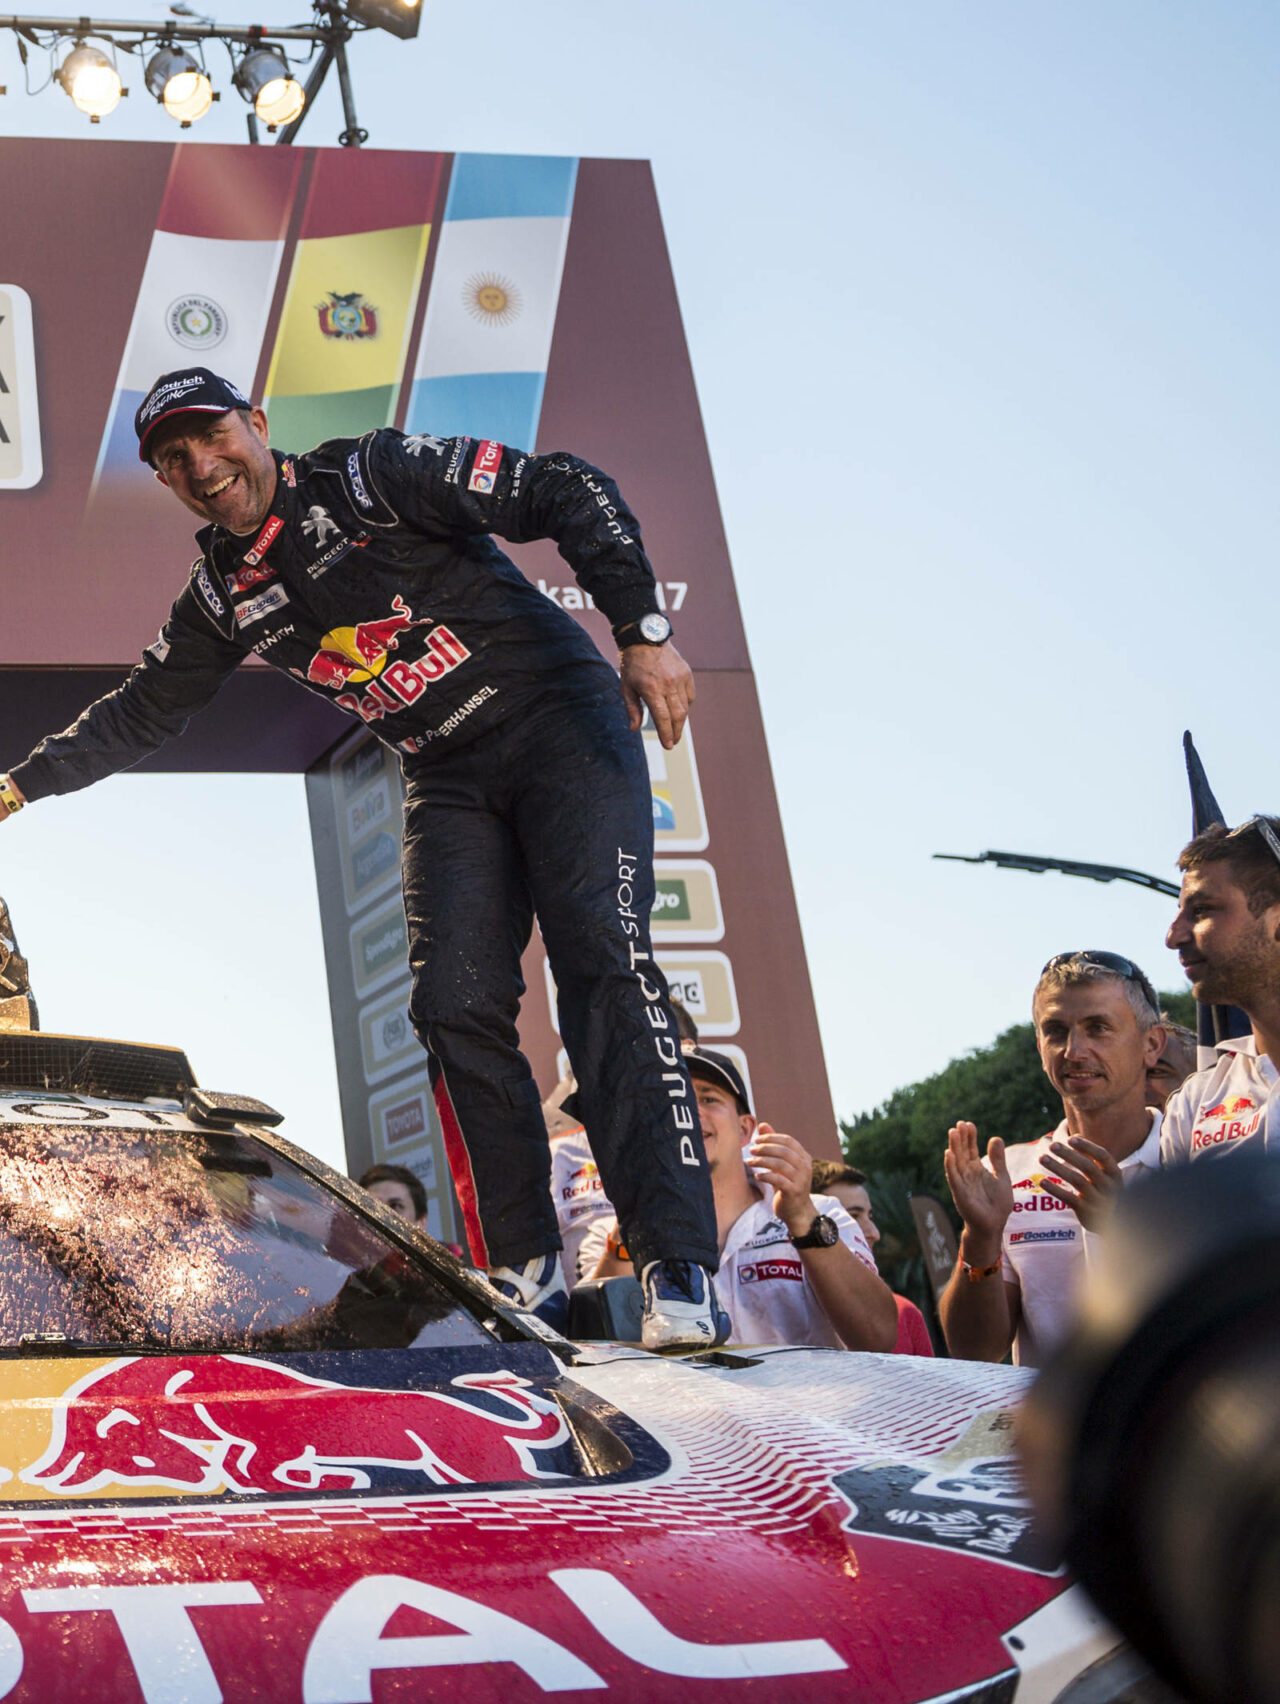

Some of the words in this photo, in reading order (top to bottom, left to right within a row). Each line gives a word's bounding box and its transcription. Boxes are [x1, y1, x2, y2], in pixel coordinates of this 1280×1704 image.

[479, 440, 499, 469] TOTA
[510, 457, 527, 498] ZENITH
[255, 519, 281, 551] TOTAL
[306, 537, 349, 574] PEUGEOT
[252, 624, 295, 654] ZENITH
[380, 625, 472, 706] Bull
[1192, 1122, 1227, 1152] Red
[1227, 1112, 1260, 1141] Bull
[562, 1179, 590, 1200] Red
[1012, 1195, 1038, 1213] ed
[1040, 1195, 1071, 1212] Bu
[1009, 1229, 1076, 1243] BFGoodrich
[757, 1264, 803, 1278] TOTAL
